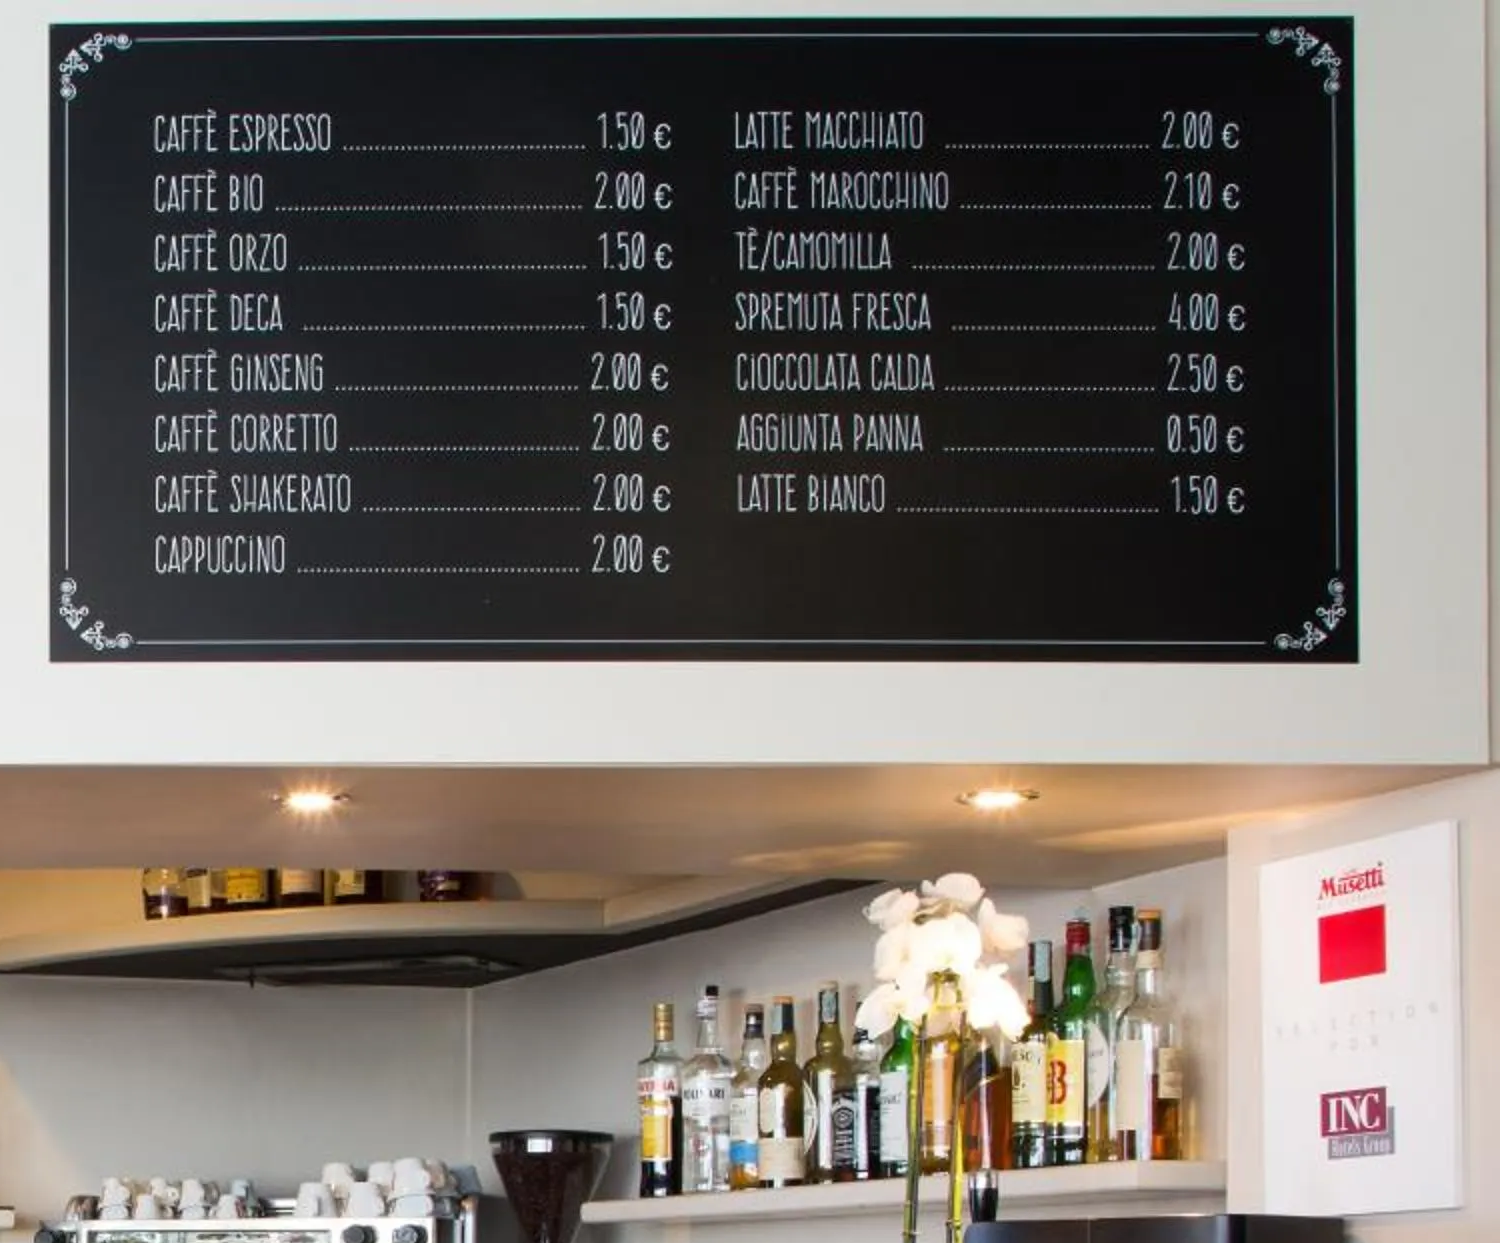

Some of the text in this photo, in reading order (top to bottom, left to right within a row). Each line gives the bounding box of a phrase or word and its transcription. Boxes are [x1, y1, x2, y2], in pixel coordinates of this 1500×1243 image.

[154, 108, 672, 153] CAFFÈ ESPRESSO 1.50 €
[734, 110, 1240, 150] LATTE MACCHIATO 2.00 €
[154, 168, 673, 213] CAFFÈ BIO 2.00 €
[734, 165, 1240, 210] CAFFÈ MAROCCHINO 2.10 €
[154, 227, 673, 273] CAFFÈ ORZO 1.50 €
[735, 226, 1245, 272] TÈ/CAMOMILLA 2.00 €
[154, 287, 672, 333] CAFFÈ DECA 1.50 €
[735, 291, 1246, 332] SPREMUTA FRESCA 4.00 €
[154, 348, 669, 393] CAFFÈ GINSENG 2.00 €
[736, 352, 1244, 393] CIOCCOLATA CALDA 2.50 €
[154, 408, 670, 453] CAFFÈ CORRETTO 2.00 €
[736, 412, 1244, 454] AGGIUNTA PANNA 0.50 €
[155, 469, 671, 513] CAFFÈ SHAKERATO 2.00 €
[737, 473, 1245, 515] LATTE BIANCO 1.50 €
[155, 533, 670, 575] CAPPUCCINO 2.00 €
[1317, 862, 1385, 900] Musetti
[1328, 1093, 1380, 1132] INC
